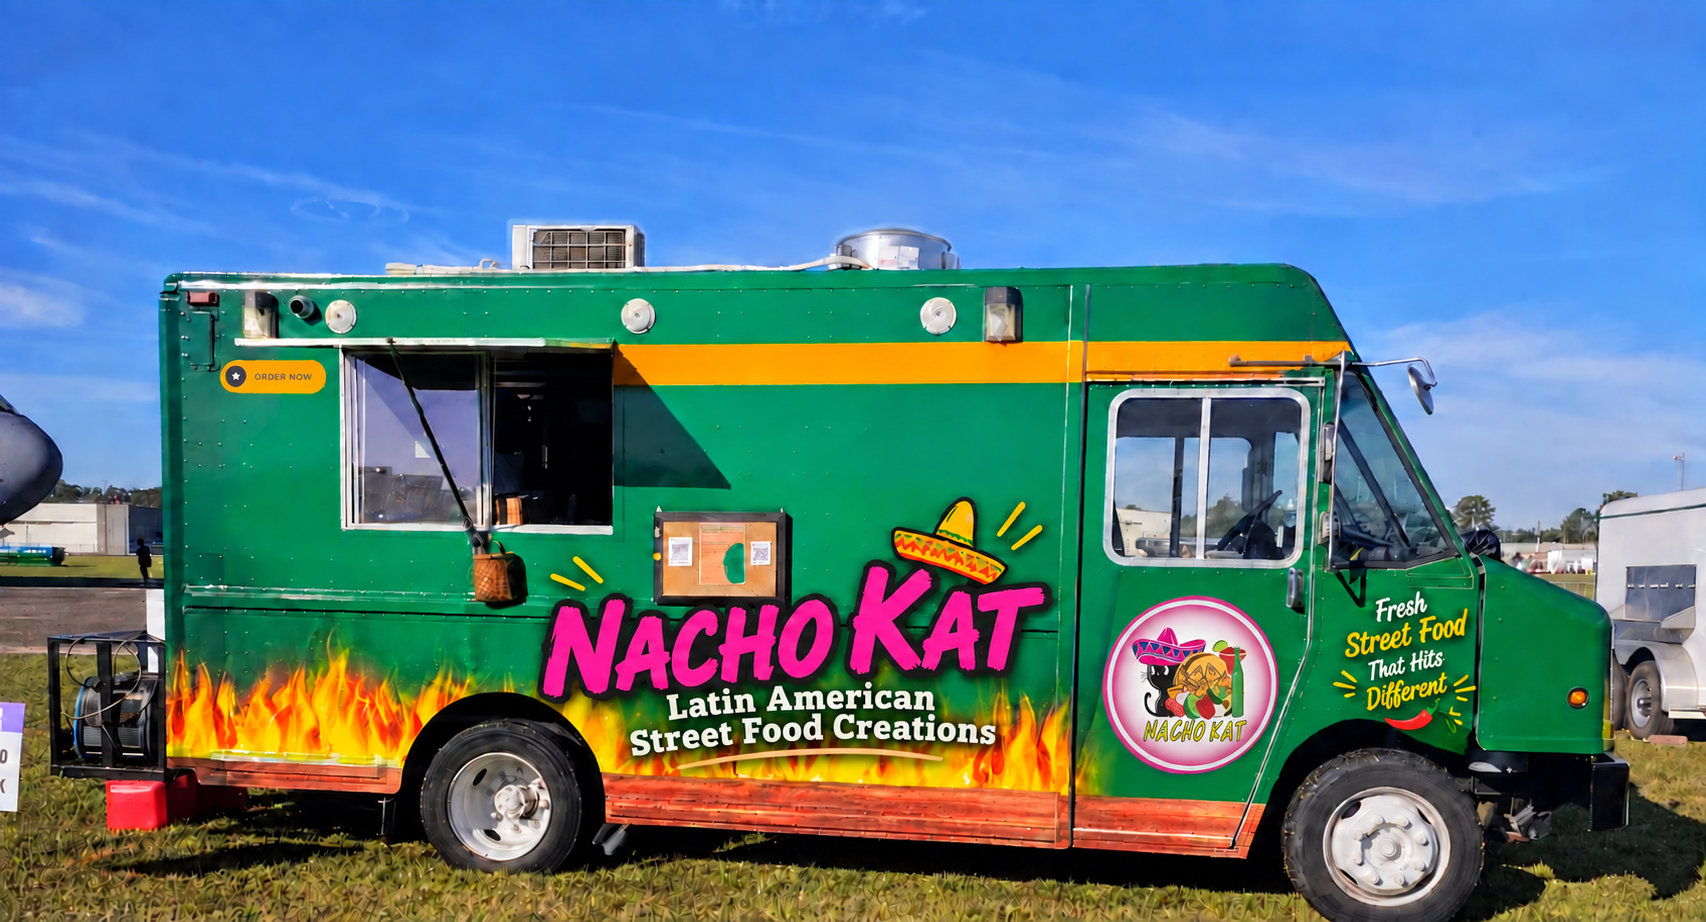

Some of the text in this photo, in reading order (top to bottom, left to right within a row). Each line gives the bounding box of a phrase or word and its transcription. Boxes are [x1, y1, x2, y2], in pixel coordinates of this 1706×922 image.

[254, 373, 313, 381] ORDER NOW
[1375, 591, 1427, 622] Fresh
[1345, 608, 1468, 658] Street Food
[1368, 650, 1443, 681] That Hits
[667, 682, 935, 720] Latin American
[1366, 672, 1448, 711] Different
[631, 713, 996, 756] Street Food Creations
[1143, 719, 1247, 742] NACHO KAT
